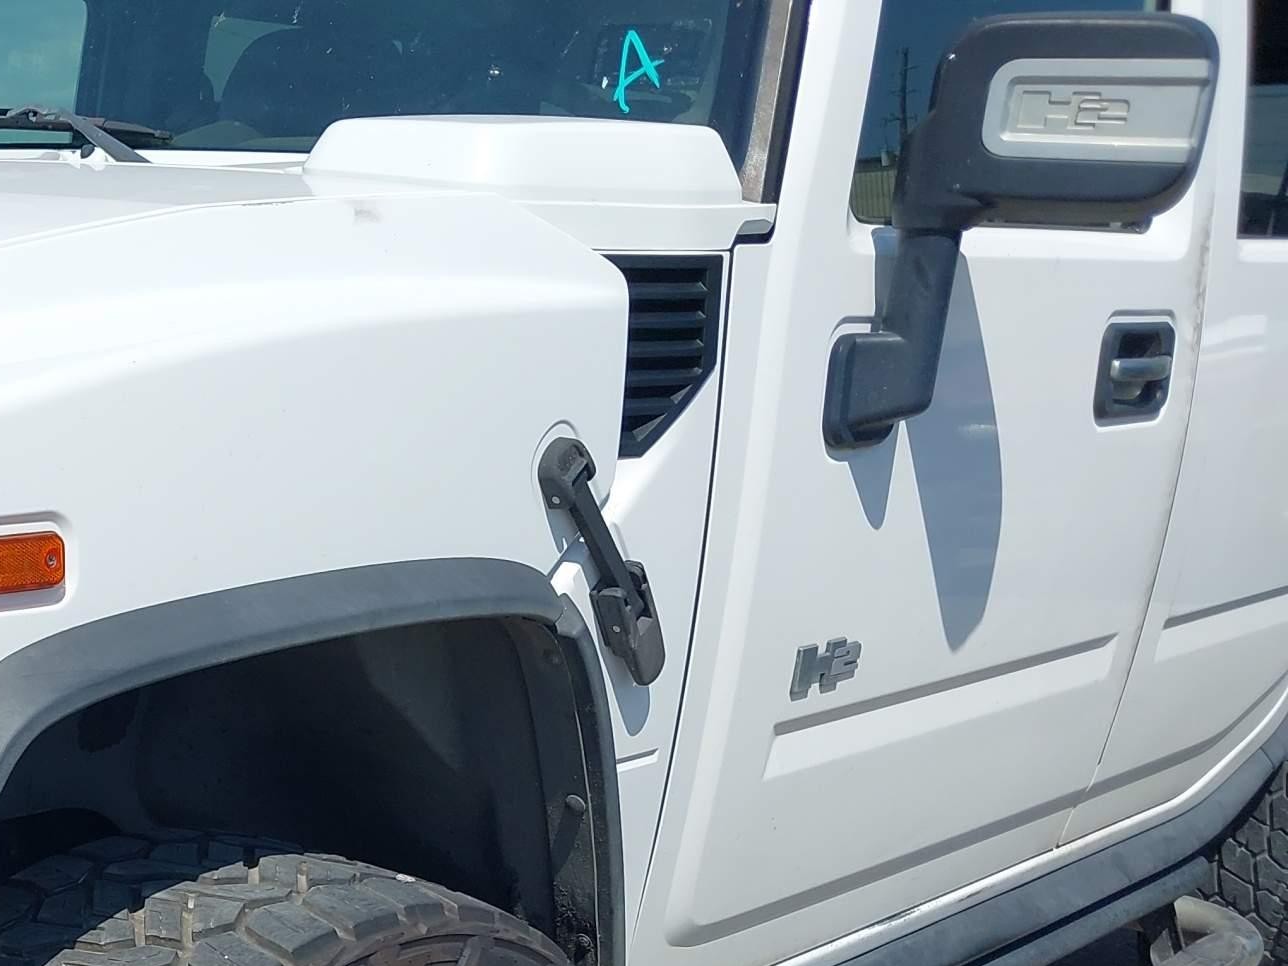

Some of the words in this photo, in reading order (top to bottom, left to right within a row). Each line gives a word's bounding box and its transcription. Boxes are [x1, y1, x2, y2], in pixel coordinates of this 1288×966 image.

[613, 29, 665, 114] A
[1016, 90, 1130, 130] H2
[788, 635, 862, 703] H2
